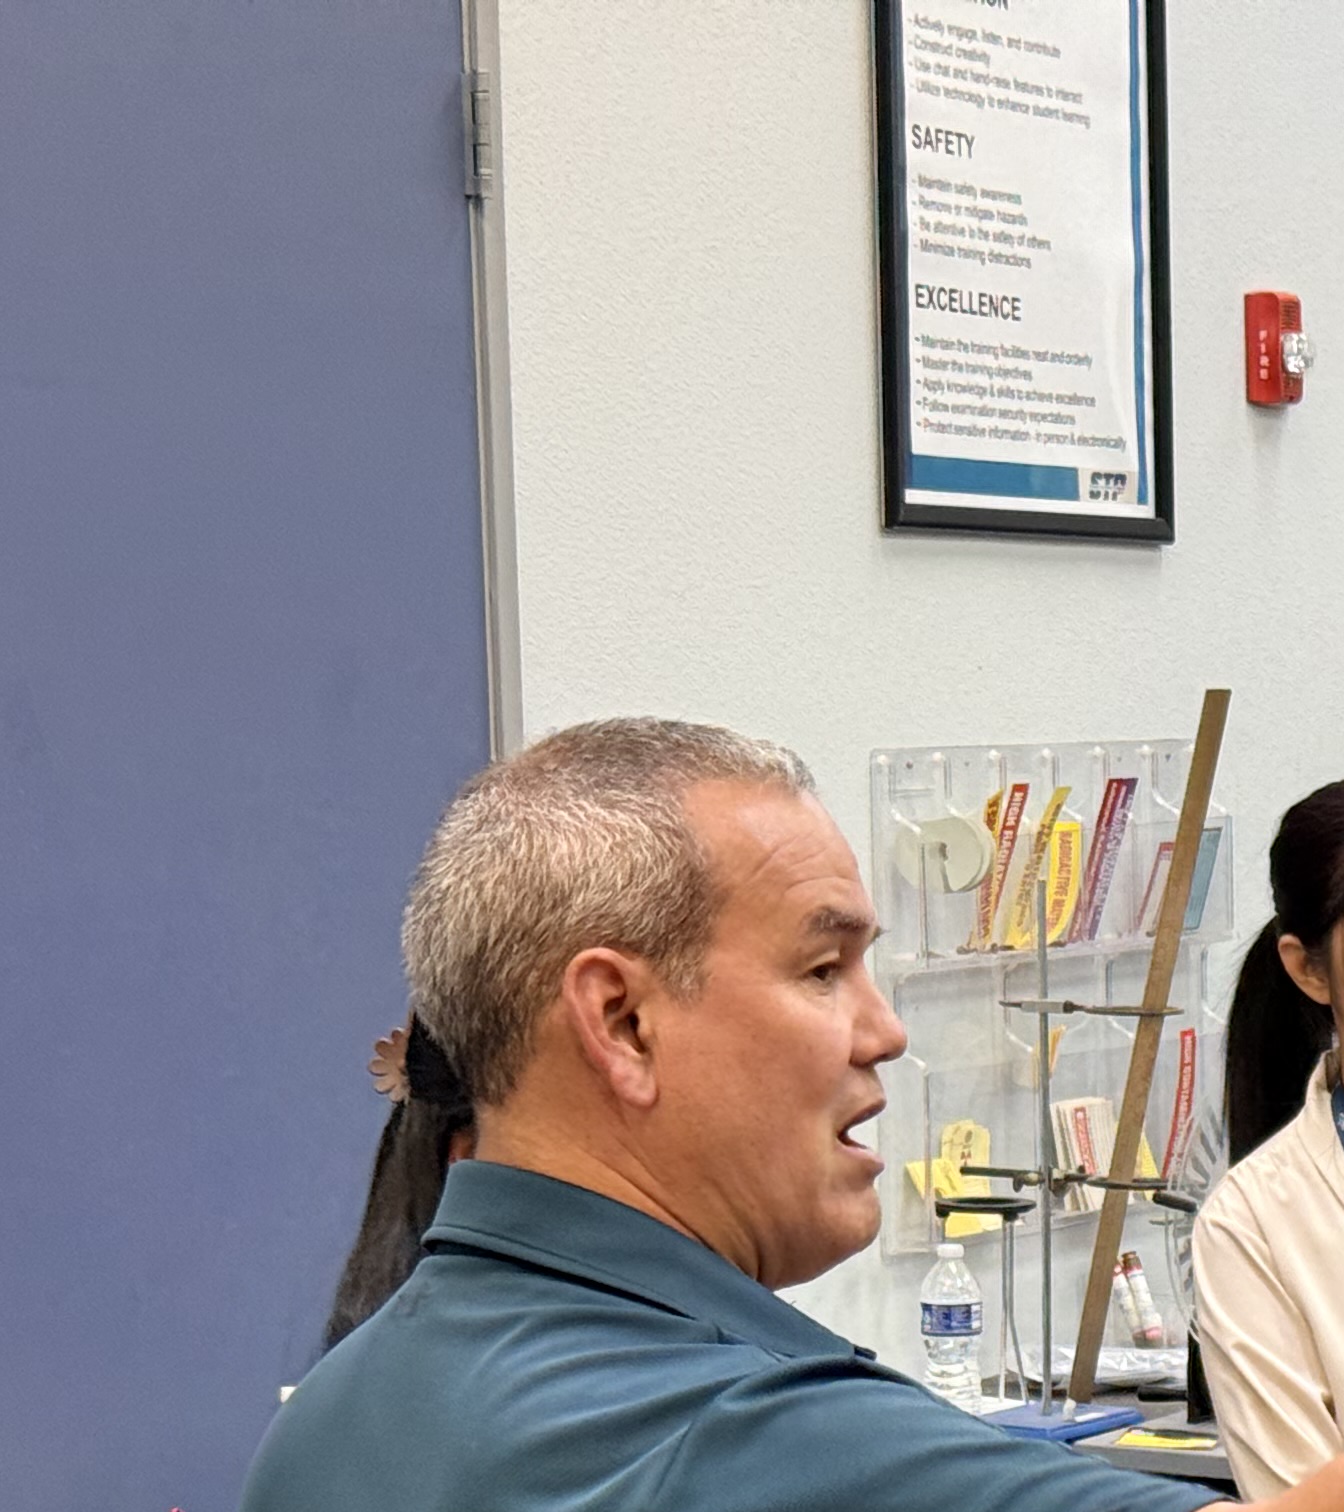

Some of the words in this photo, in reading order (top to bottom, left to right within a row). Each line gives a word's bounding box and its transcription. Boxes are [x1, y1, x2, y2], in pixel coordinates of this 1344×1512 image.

[912, 123, 975, 158] SAFETY
[915, 283, 1022, 322] EXCELLENCE
[1259, 329, 1270, 380] FIRE
